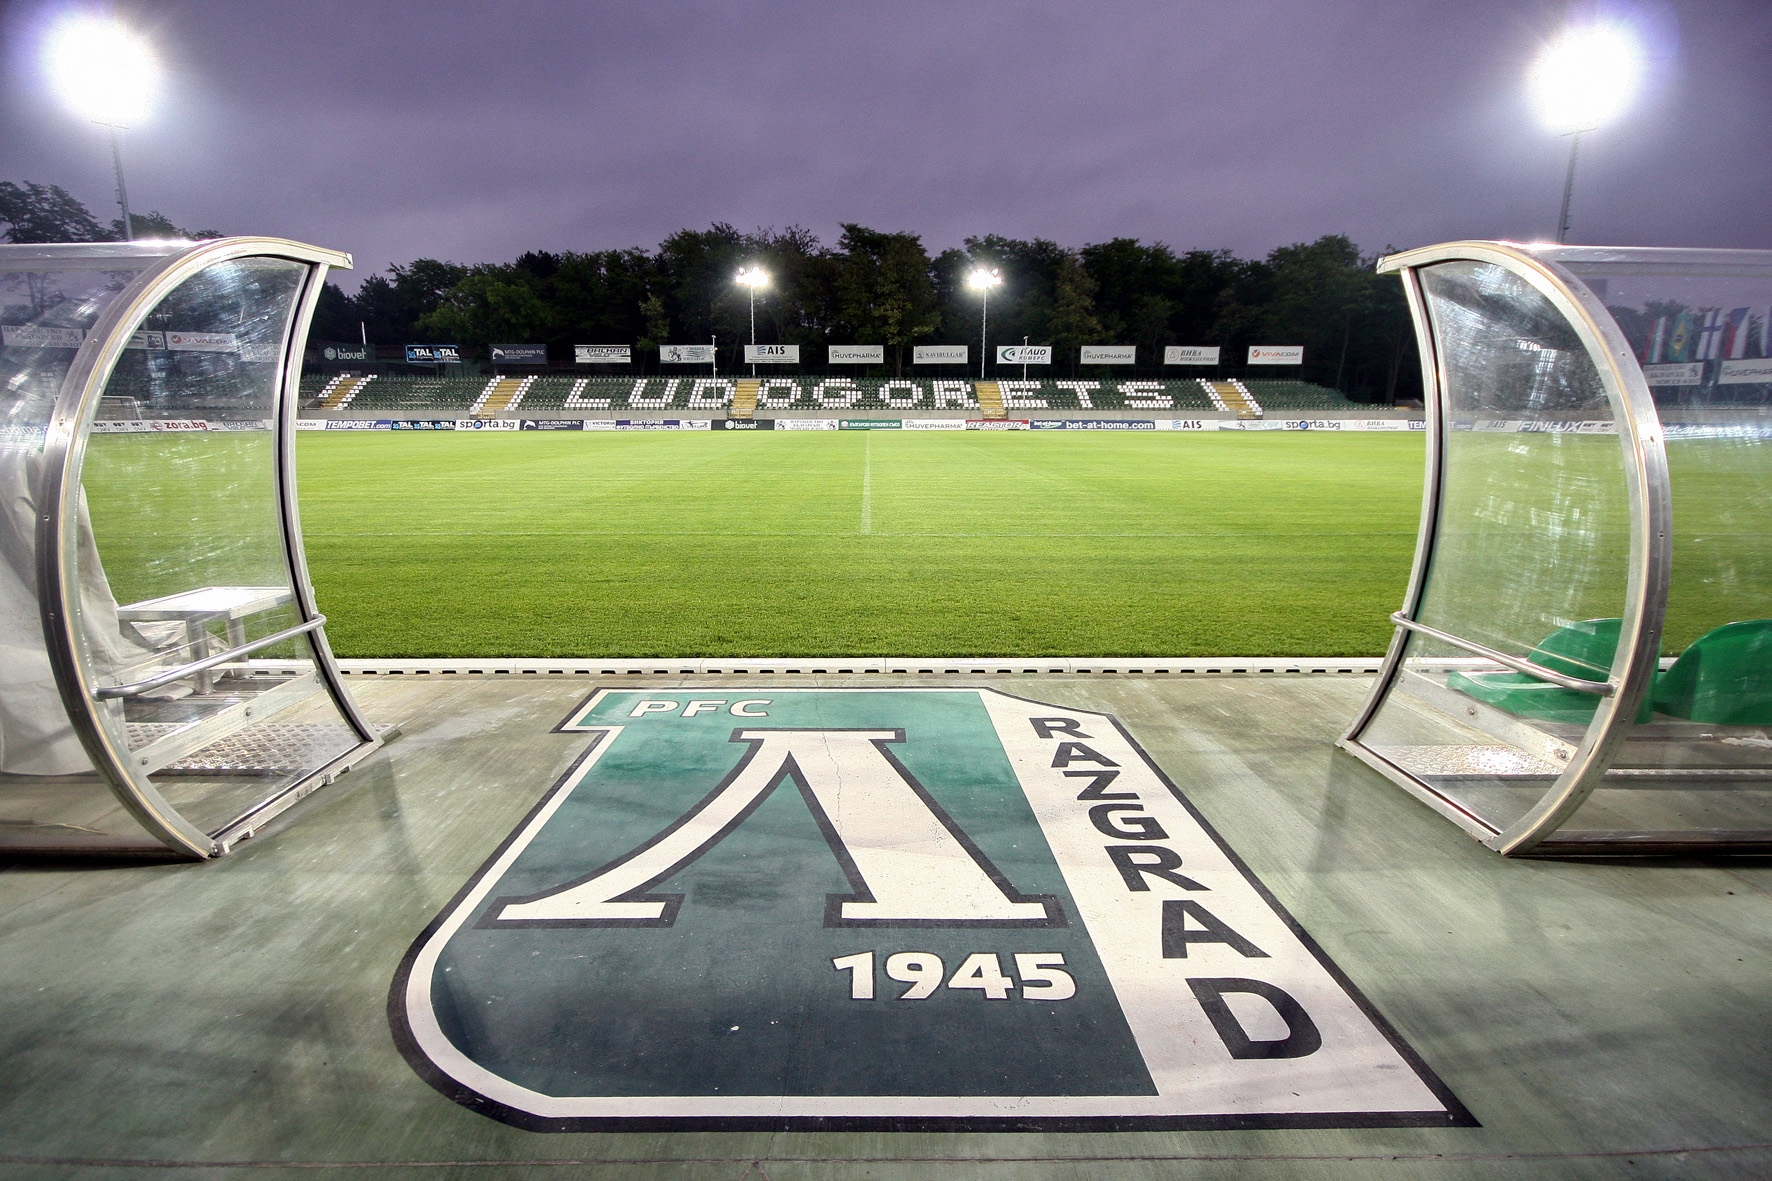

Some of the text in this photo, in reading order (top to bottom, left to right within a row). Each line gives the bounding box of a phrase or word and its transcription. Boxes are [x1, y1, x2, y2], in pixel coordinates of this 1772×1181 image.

[337, 348, 366, 360] biovet
[414, 348, 433, 357] TAL
[439, 348, 459, 357] TAL
[767, 346, 785, 355] AIS
[164, 421, 208, 431] zora.bg
[327, 421, 392, 429] TEMPOBET.com
[735, 420, 758, 429] biovet
[1066, 421, 1154, 429] bet-at-home.com
[1183, 421, 1202, 429] AIS
[1519, 421, 1584, 432] FINLUX
[629, 699, 773, 717] PFC
[1028, 717, 1323, 1060] RAZGRAD
[831, 951, 1077, 1000] 1945
